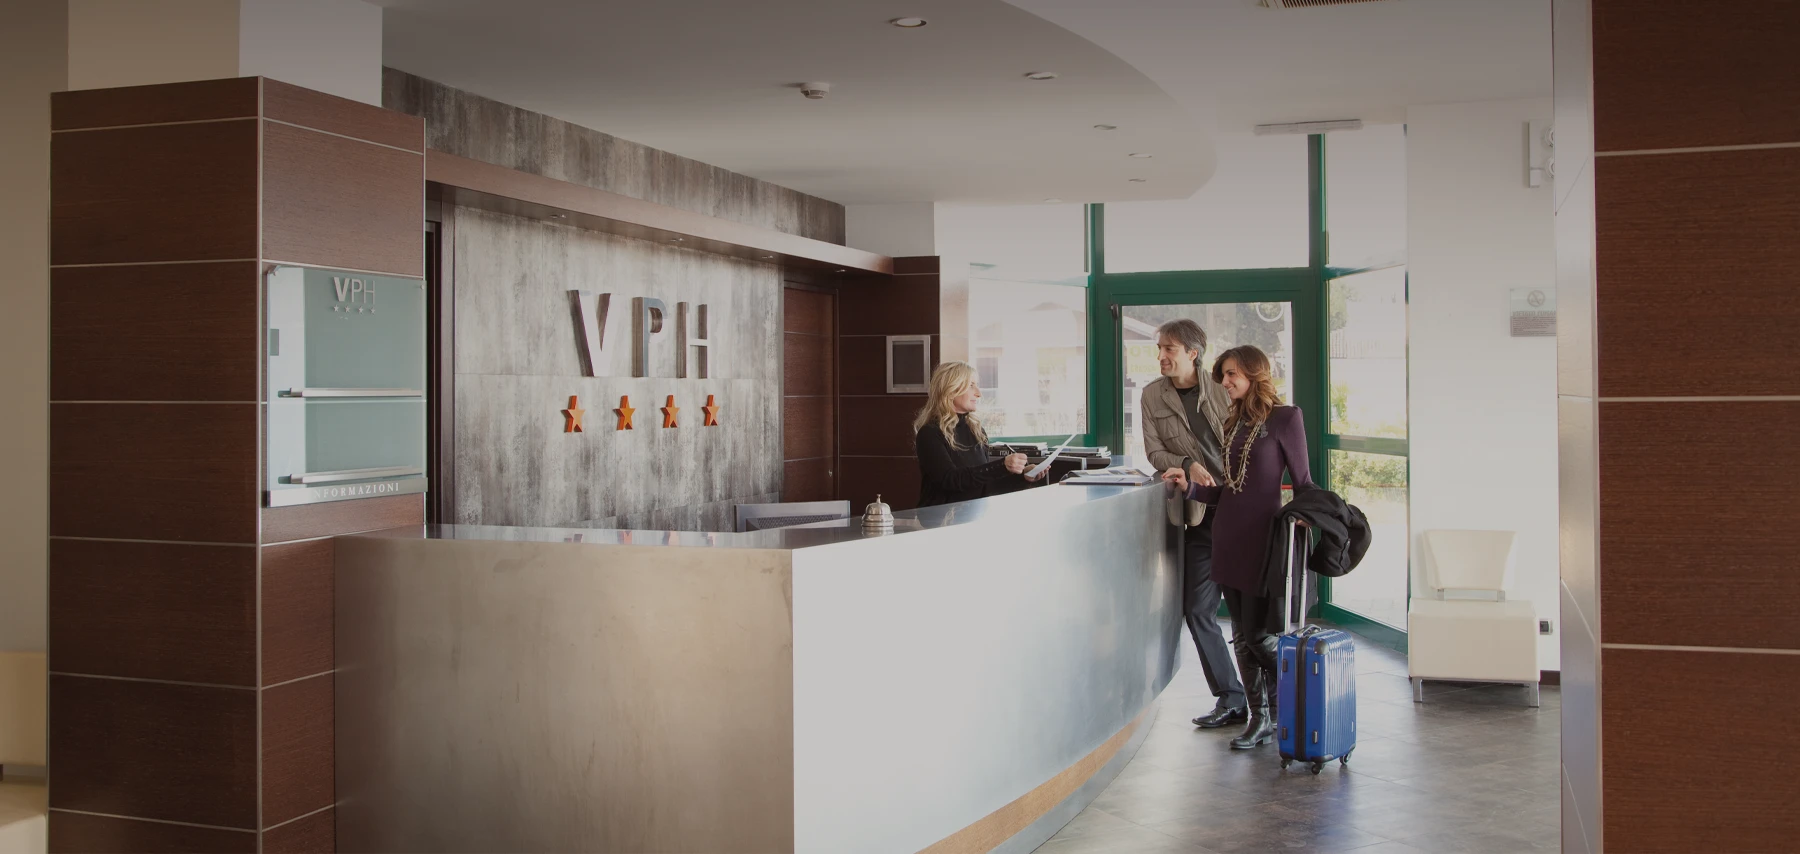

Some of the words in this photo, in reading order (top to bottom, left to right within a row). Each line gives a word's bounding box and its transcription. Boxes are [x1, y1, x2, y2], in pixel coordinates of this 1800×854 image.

[333, 276, 376, 305] VPH
[566, 289, 713, 379] VPH
[312, 482, 399, 500] NFORMAZIONI
